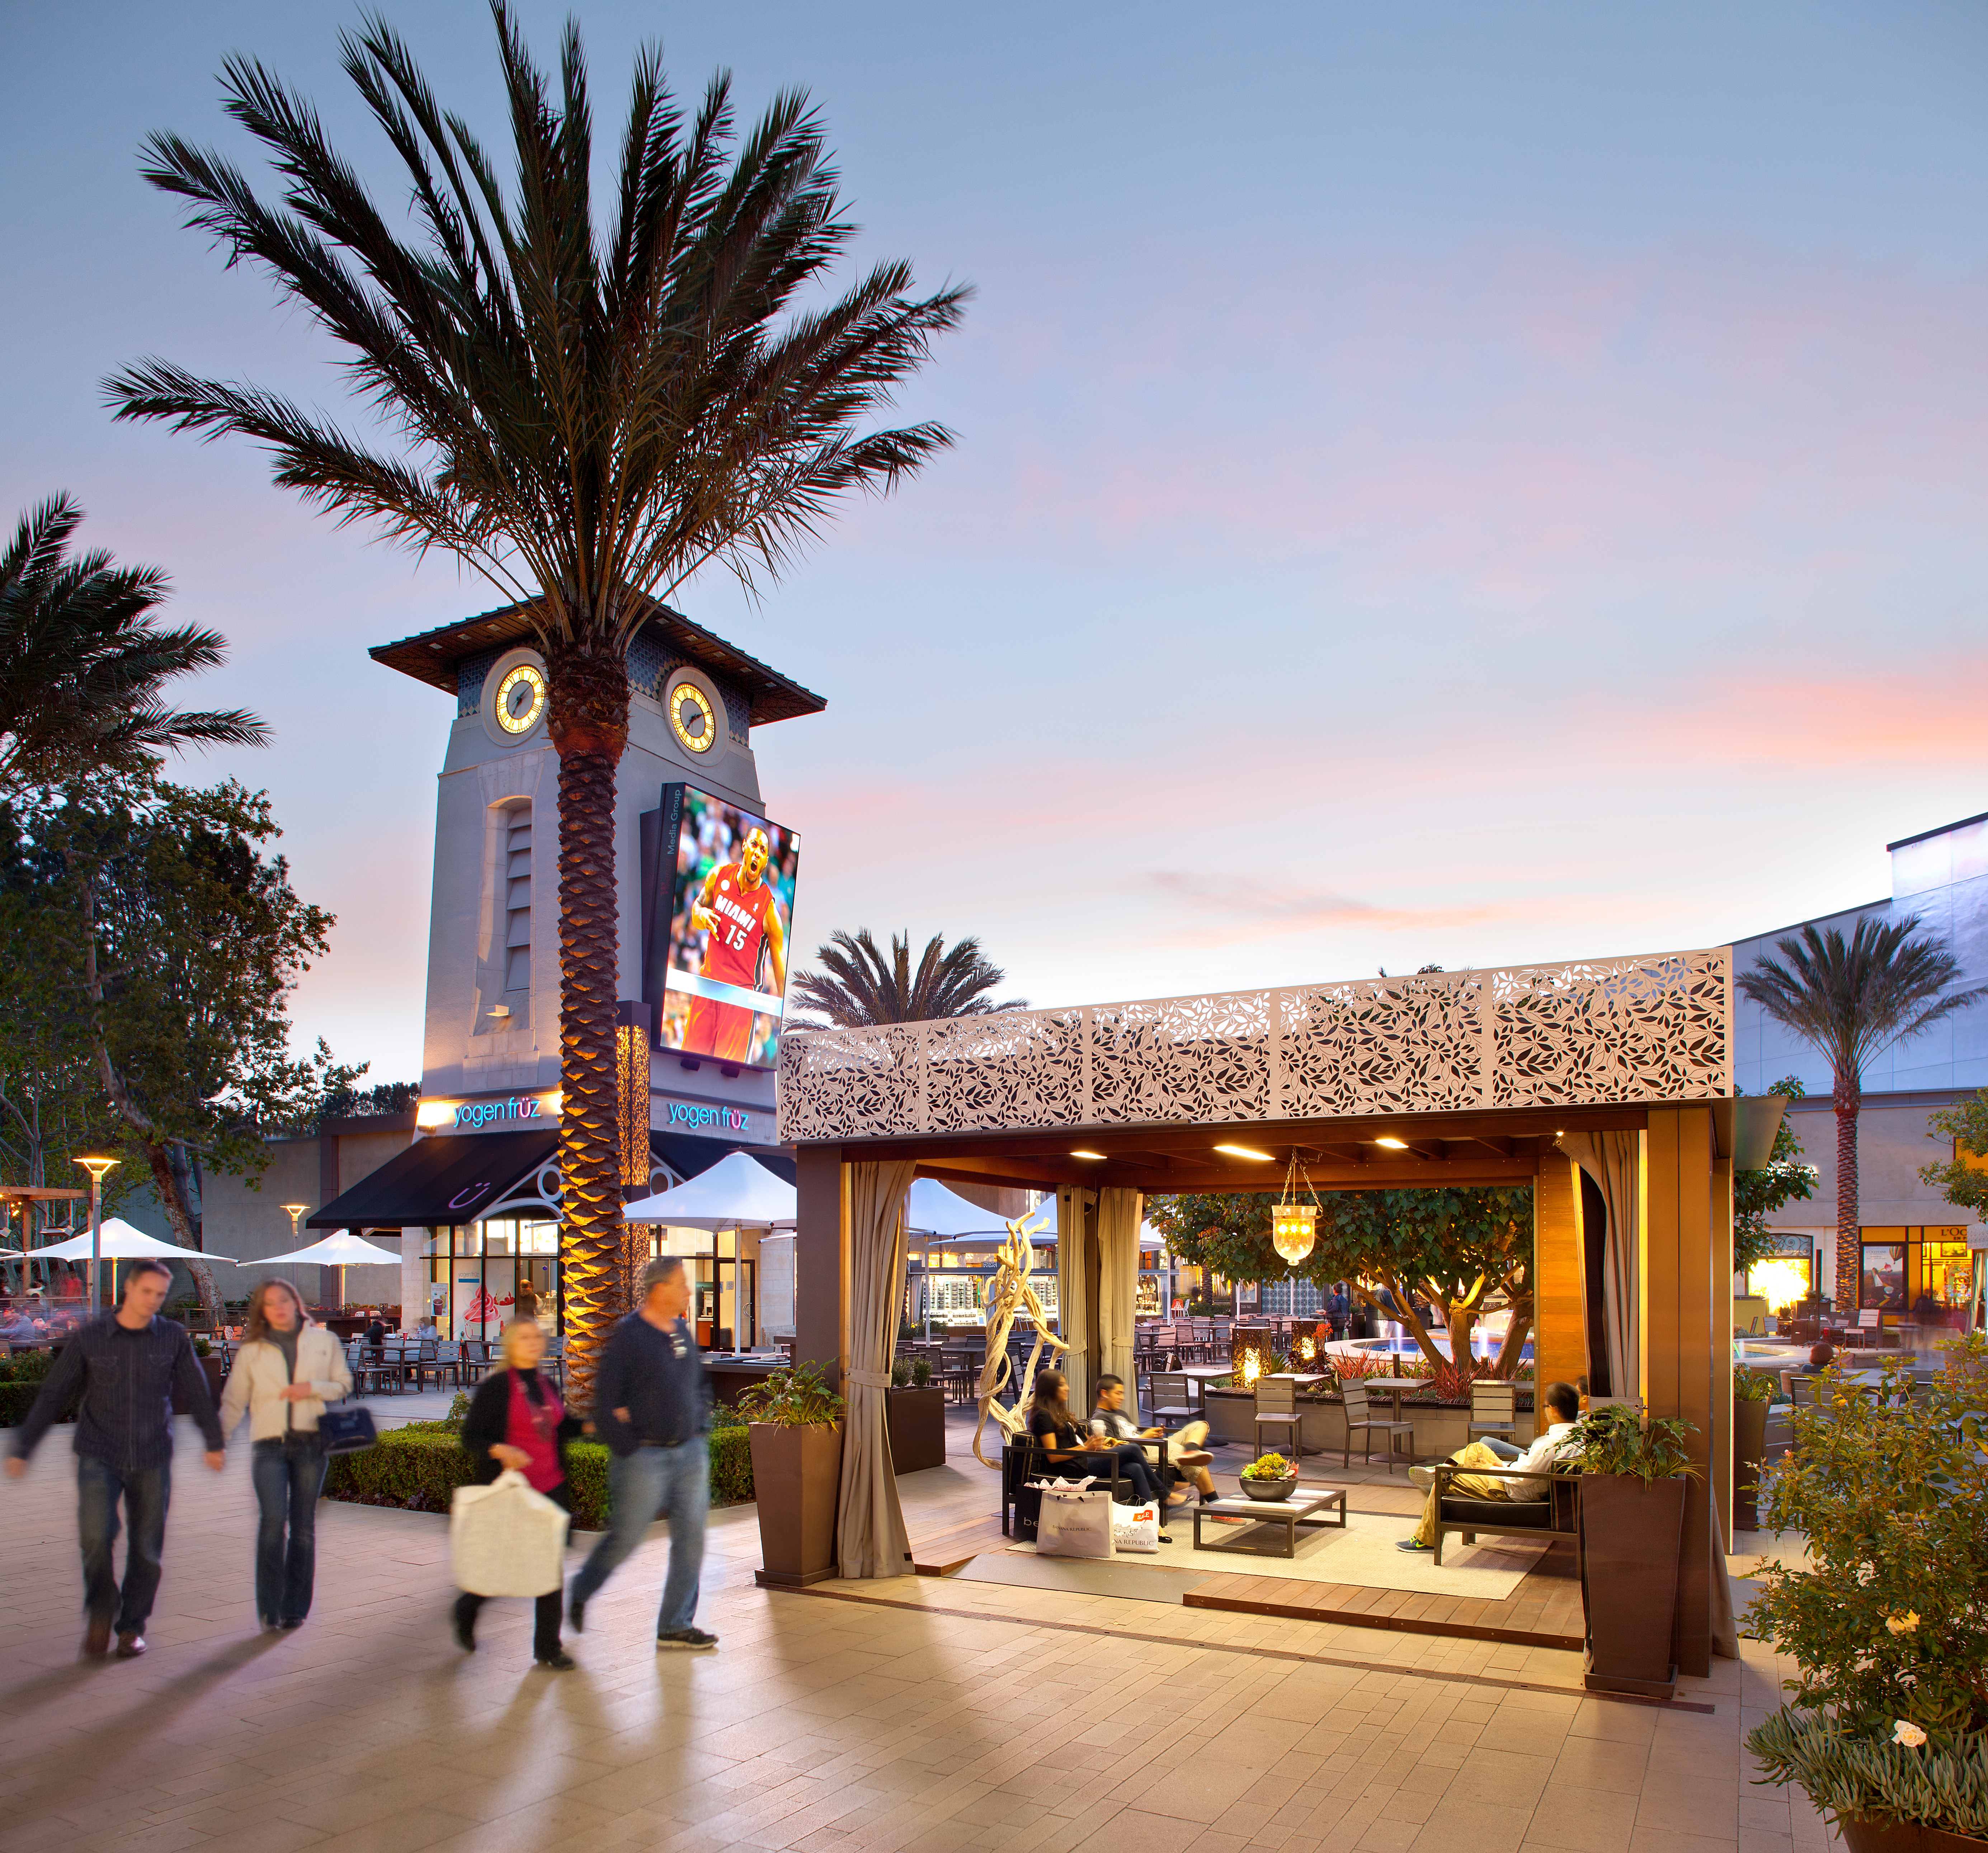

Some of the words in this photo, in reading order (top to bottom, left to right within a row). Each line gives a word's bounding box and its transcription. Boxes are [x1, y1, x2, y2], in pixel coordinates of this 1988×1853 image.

[670, 789, 681, 822] Group
[667, 824, 678, 855] Media
[715, 894, 757, 932] MIAMI
[725, 924, 748, 951] 15
[453, 1103, 504, 1128] yogen
[508, 1097, 541, 1119] früz
[669, 1103, 718, 1128] yogen
[722, 1106, 749, 1130] früz
[1941, 1227, 1967, 1236] L'OC
[1023, 1517, 1039, 1527] be
